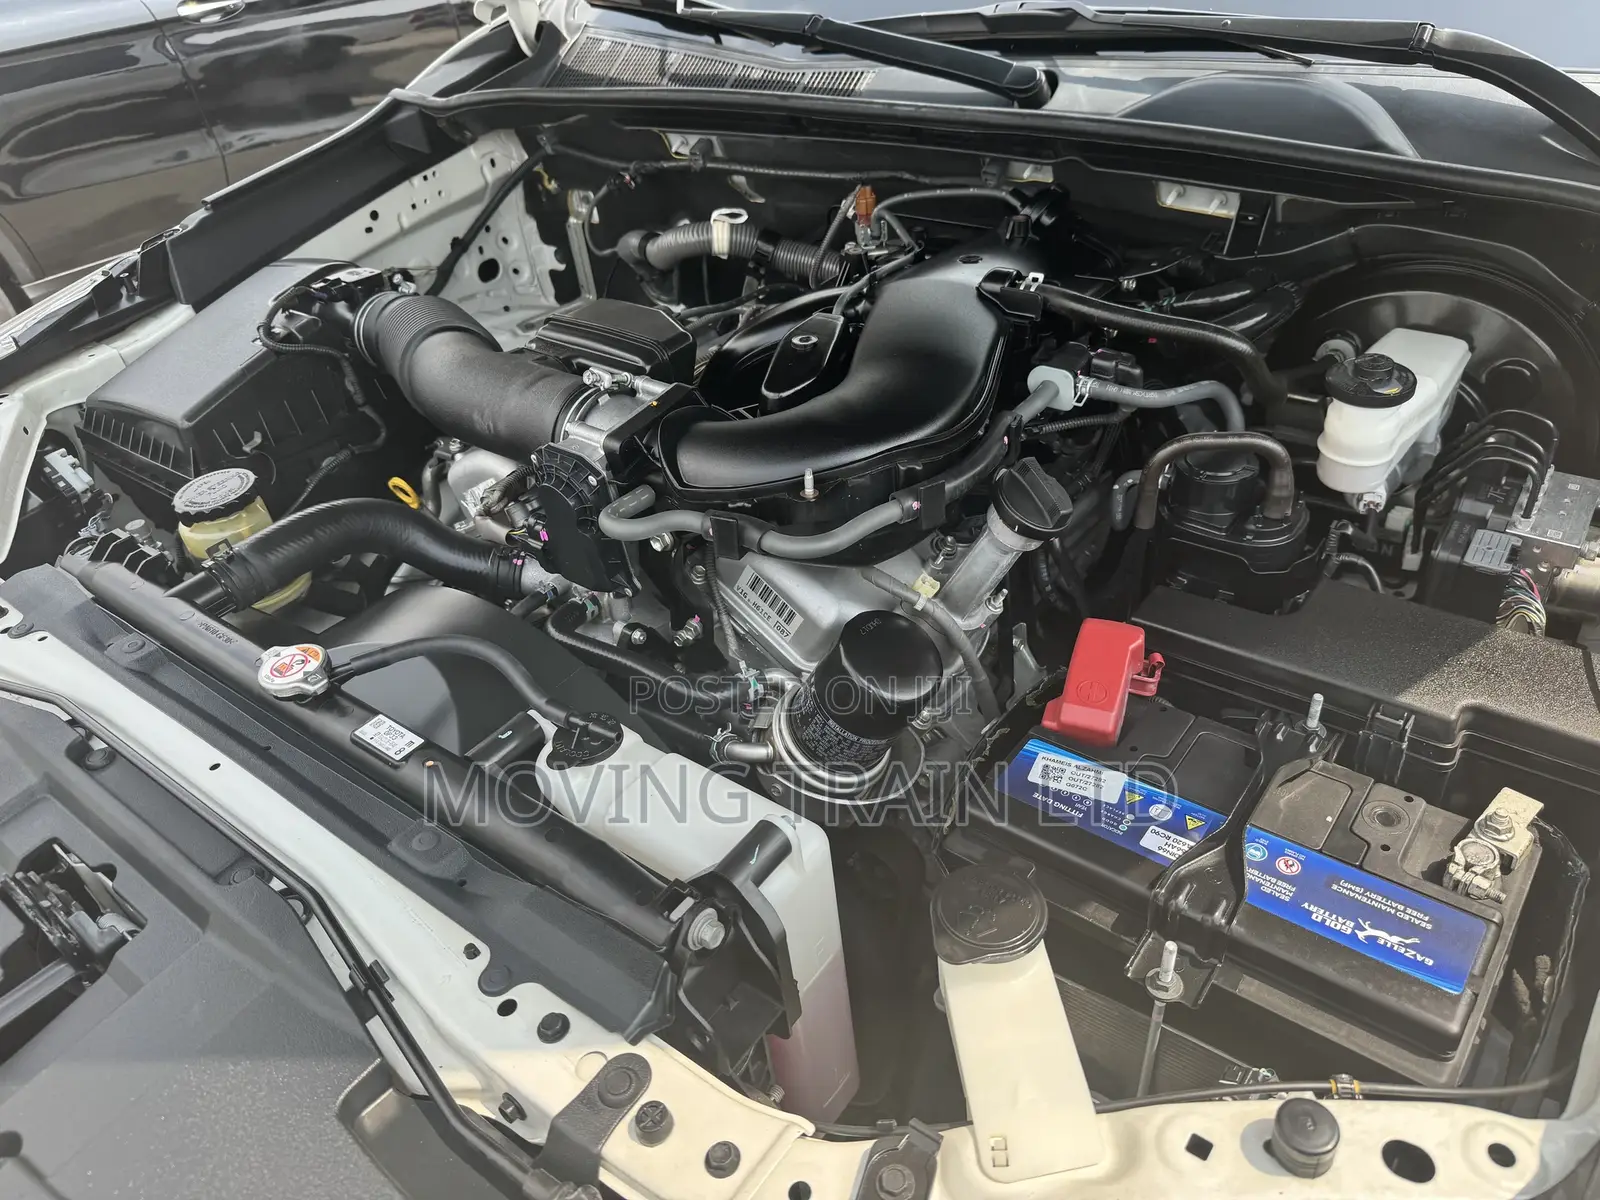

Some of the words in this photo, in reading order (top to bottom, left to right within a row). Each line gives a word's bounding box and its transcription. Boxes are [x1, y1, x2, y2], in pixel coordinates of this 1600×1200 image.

[1032, 792, 1053, 805] DATE
[1053, 801, 1084, 818] FITTING
[1150, 828, 1172, 841] RC90
[1260, 885, 1291, 902] SEALED
[1331, 883, 1396, 915] MAINTENANCE
[1365, 890, 1405, 910] BATTERY
[1301, 902, 1355, 927] BATTERY
[1396, 911, 1433, 930] SEALED
[1405, 906, 1430, 921] FREE
[1311, 912, 1353, 935] GOLD
[1376, 937, 1435, 966] GAZELLE
